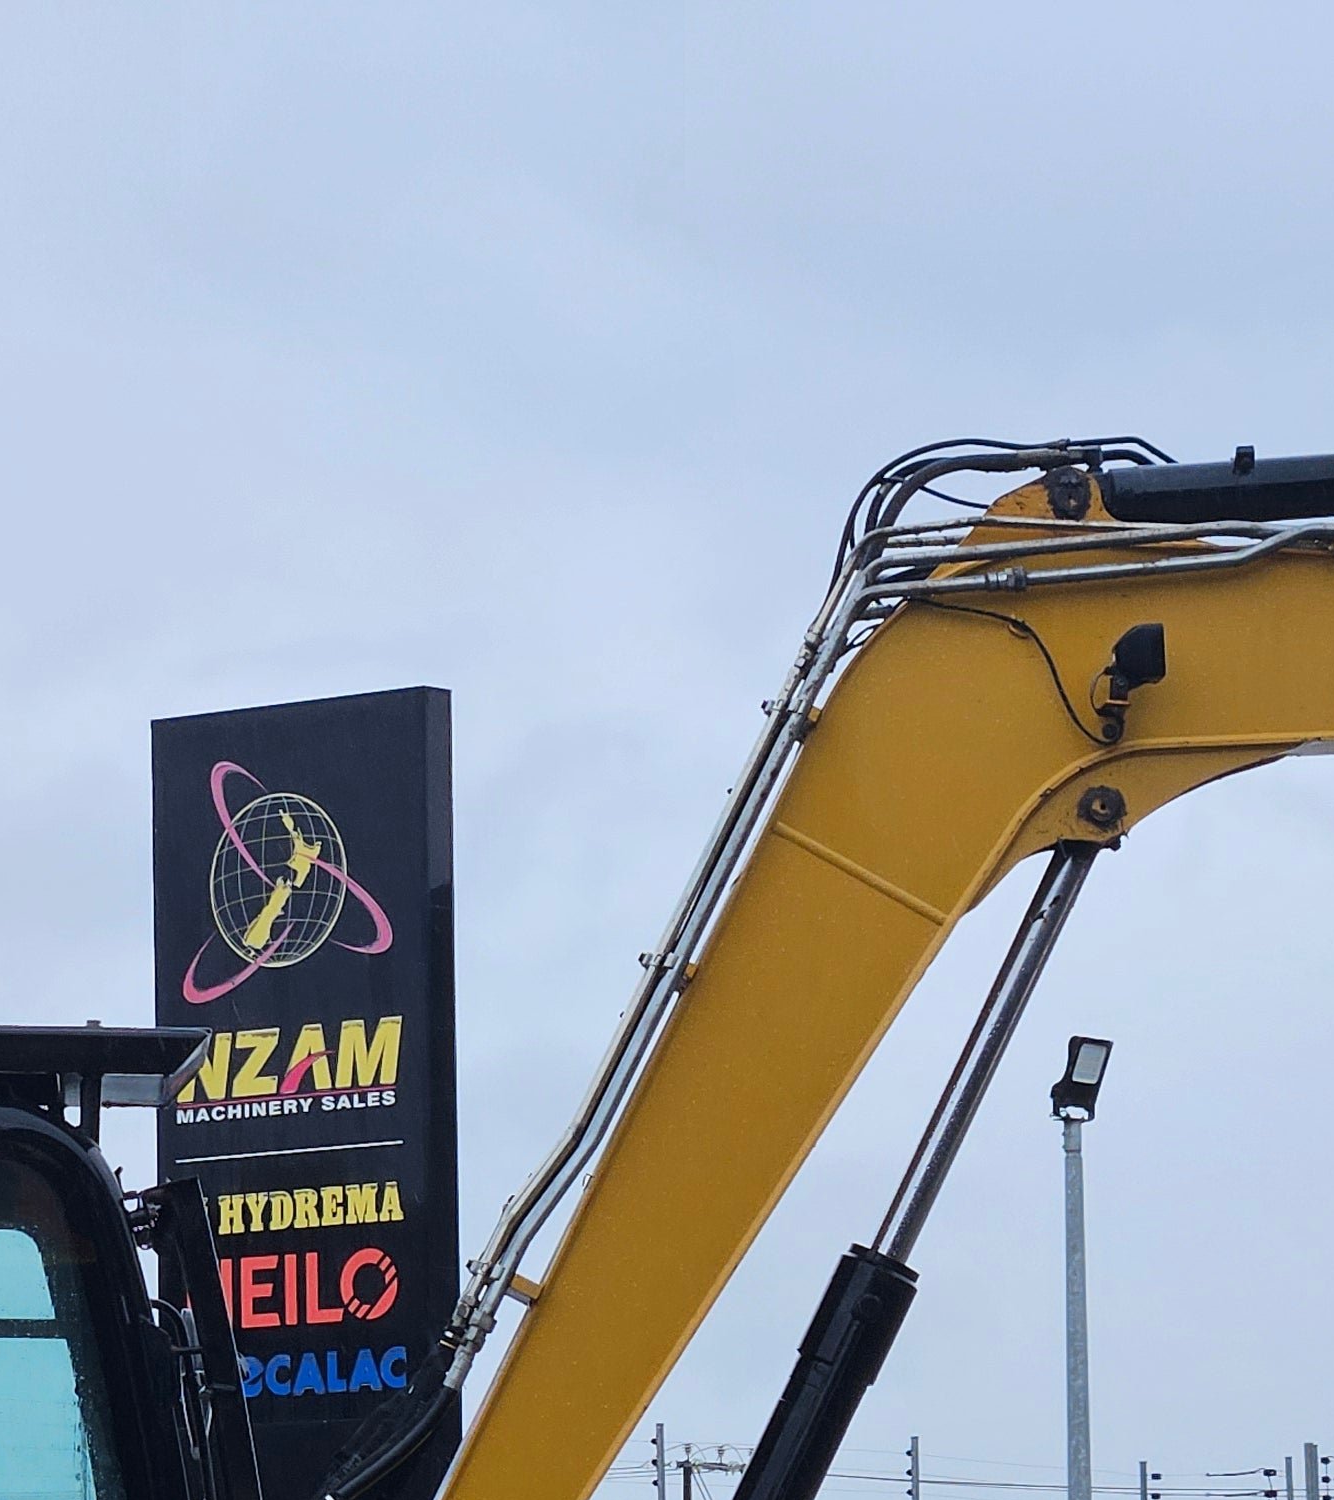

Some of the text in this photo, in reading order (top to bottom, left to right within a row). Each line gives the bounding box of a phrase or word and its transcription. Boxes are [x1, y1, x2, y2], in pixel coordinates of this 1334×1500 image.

[176, 1015, 403, 1103] NZAM
[176, 1090, 397, 1125] MACHINERY SALES
[218, 1181, 405, 1236] HYDREMA
